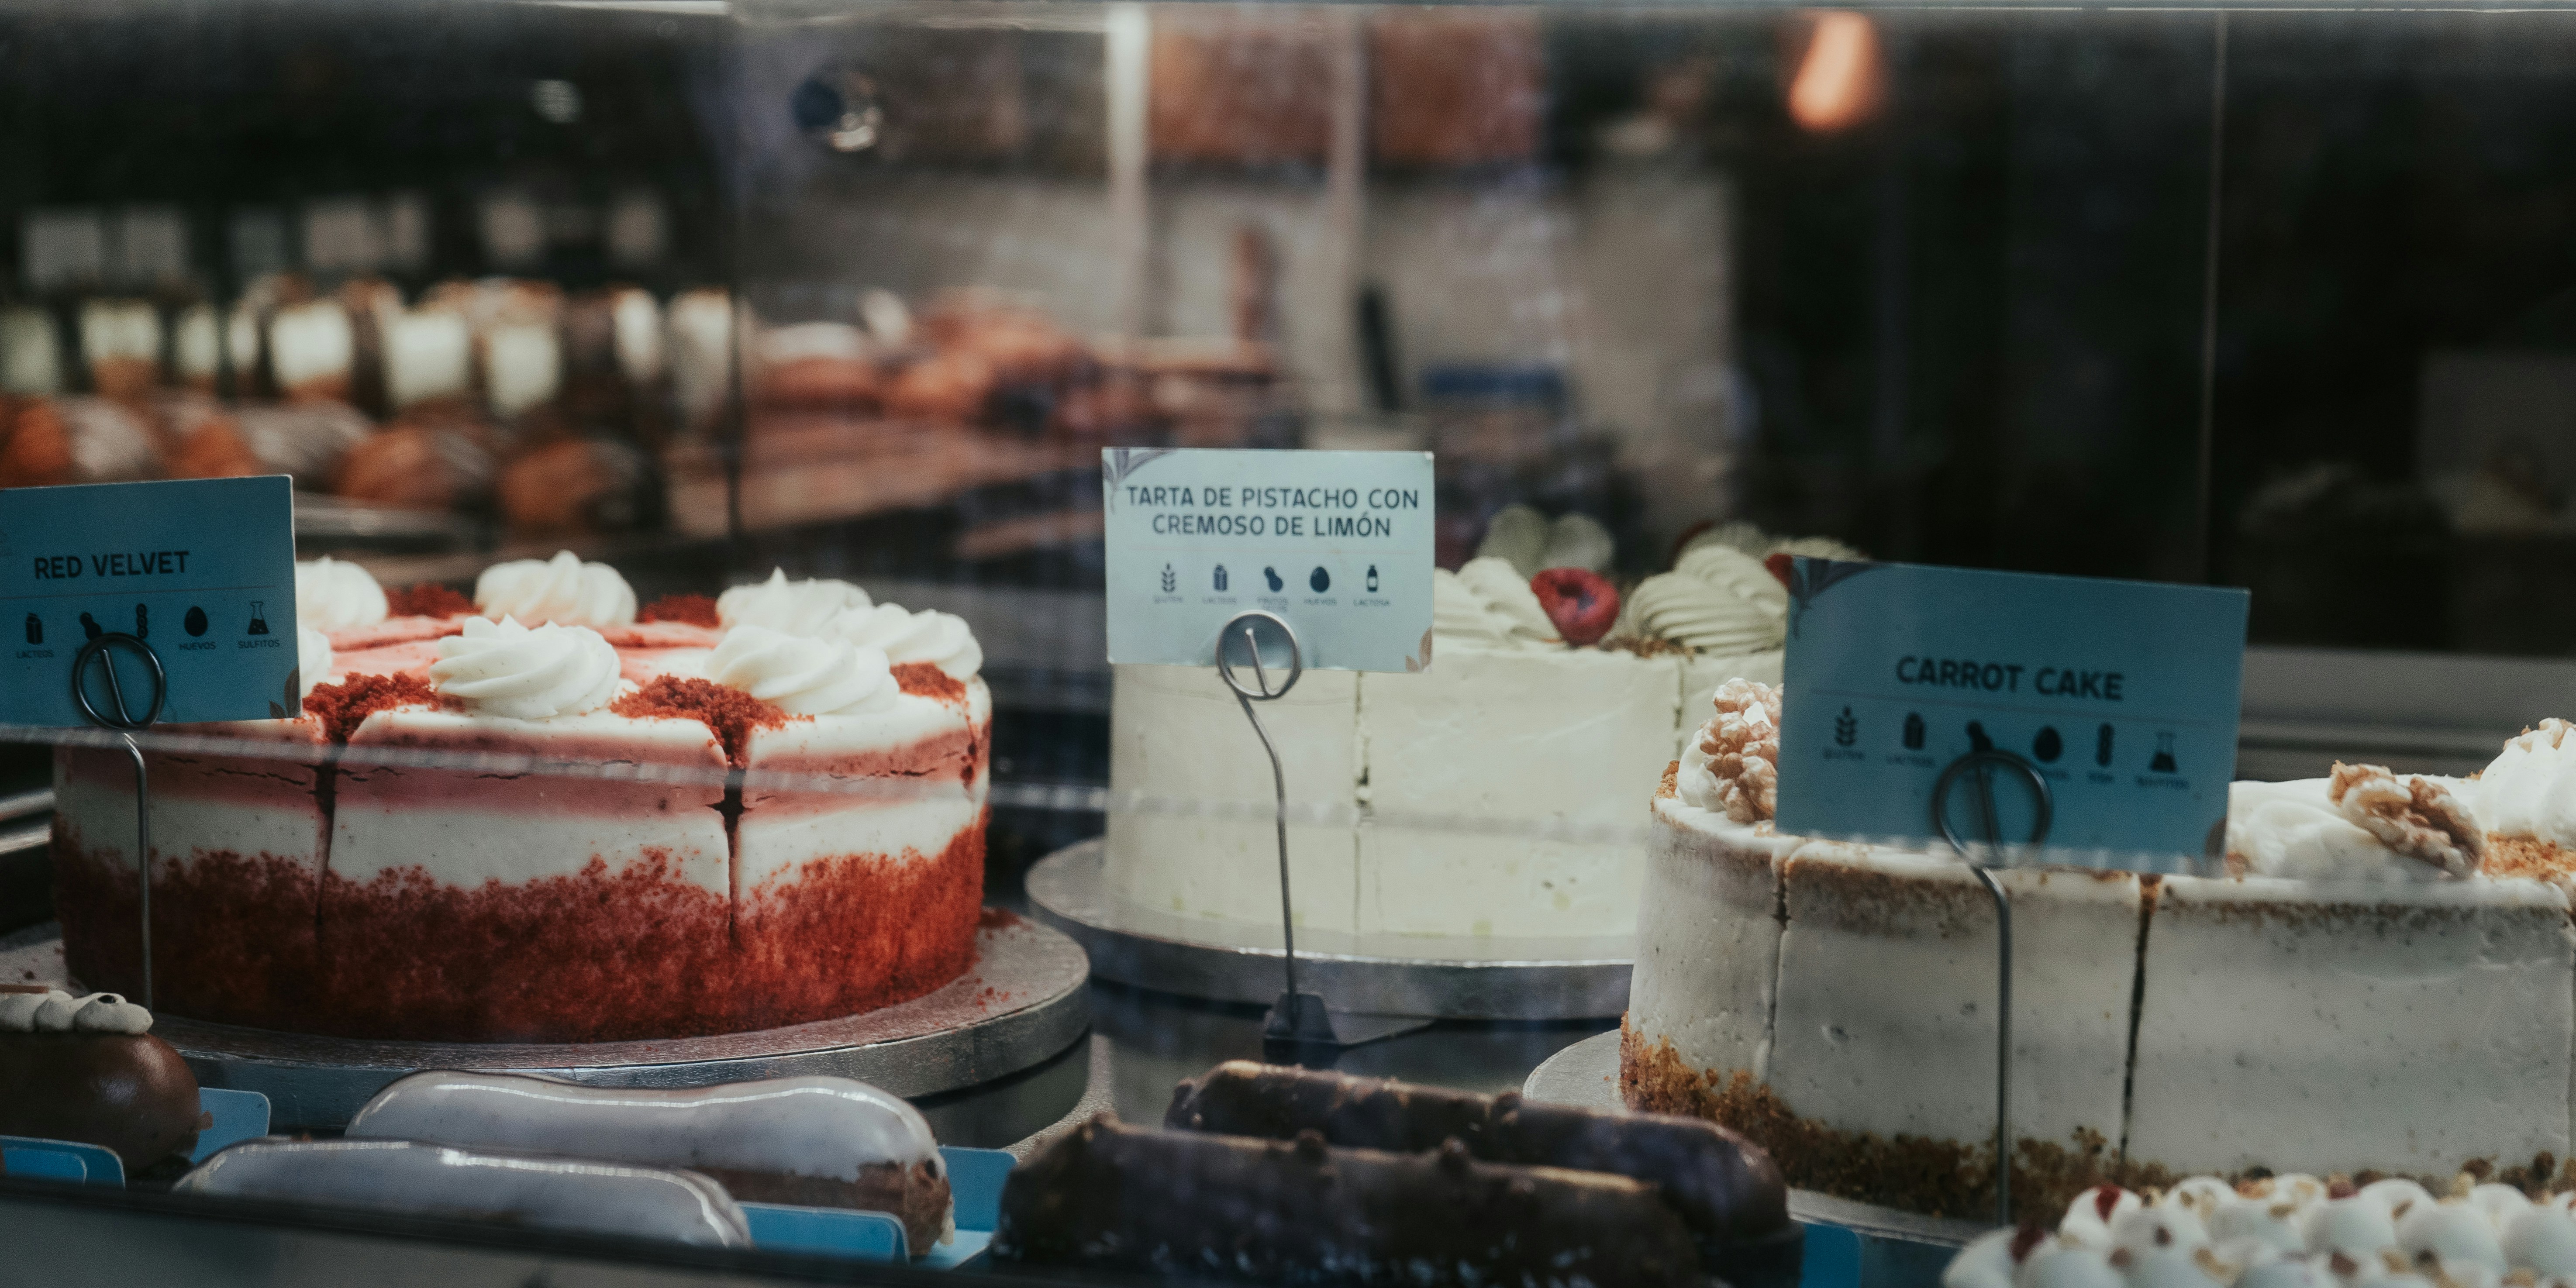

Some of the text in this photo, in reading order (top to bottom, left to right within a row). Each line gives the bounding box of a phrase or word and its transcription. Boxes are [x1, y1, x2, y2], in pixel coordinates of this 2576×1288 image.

[1127, 486, 1419, 510] TARTA DE PISTACHO CON
[1152, 510, 1391, 537] CREMOSO DE LIMÓN
[35, 550, 189, 579] RED VELVET
[179, 641, 216, 651] HUEVOS
[238, 639, 280, 649] SULFITOS
[1897, 655, 2125, 702] CARROT CAKE
